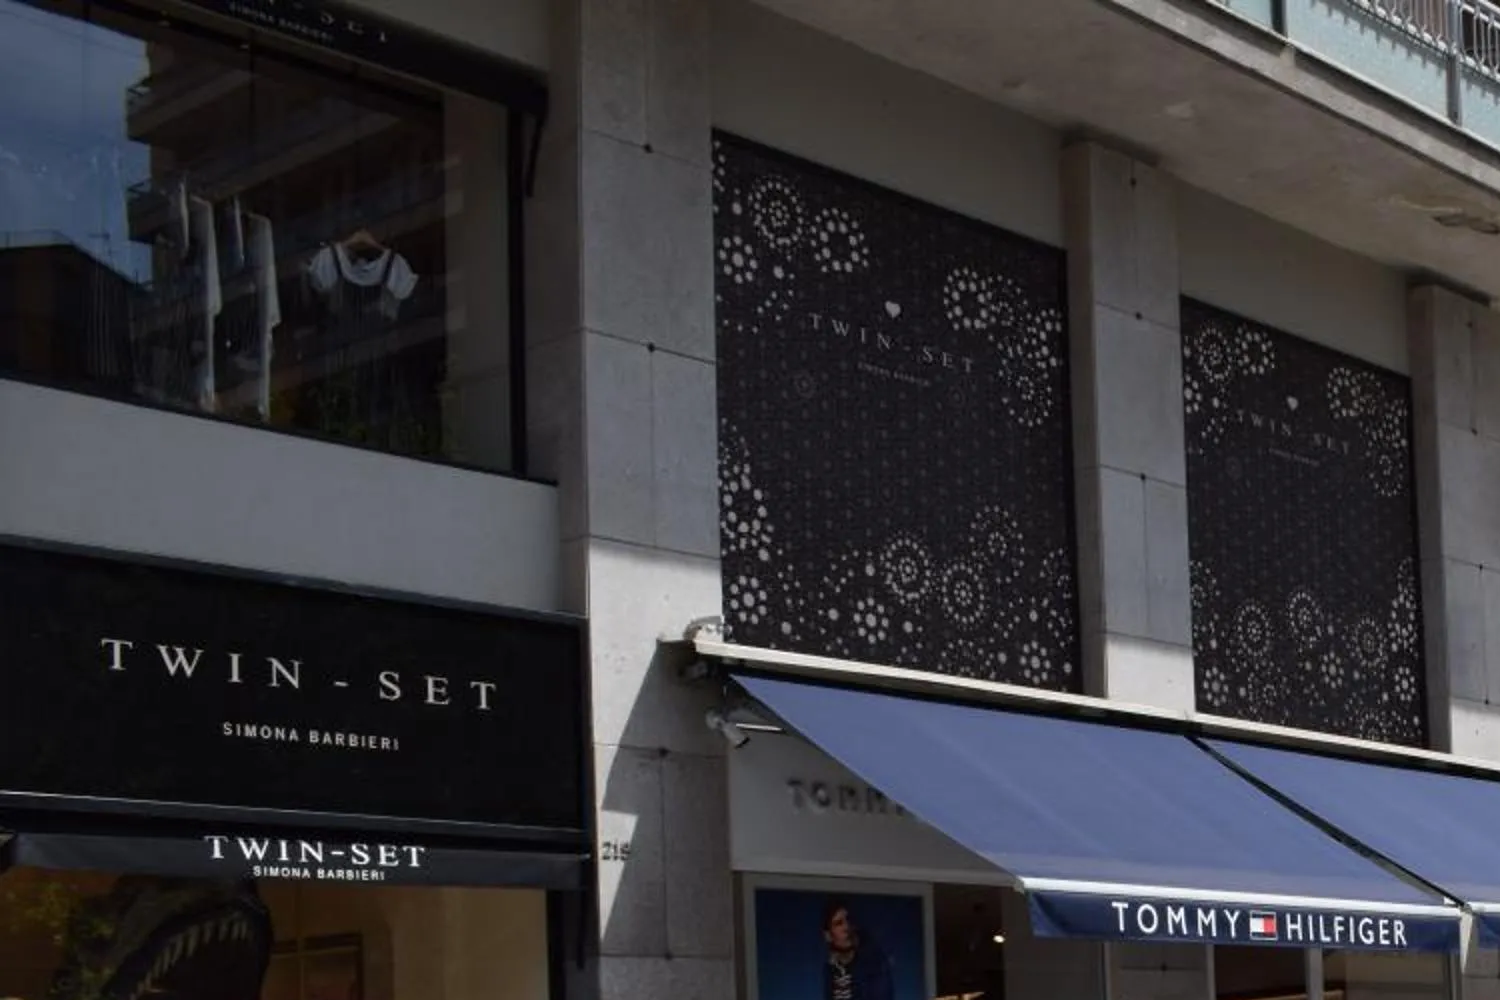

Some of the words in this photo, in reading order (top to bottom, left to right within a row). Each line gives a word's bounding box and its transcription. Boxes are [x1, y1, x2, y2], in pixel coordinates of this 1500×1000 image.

[223, 720, 299, 742] SIMONA
[309, 729, 400, 752] BARBIERI
[204, 834, 425, 867] TWIN-SET
[253, 865, 310, 879] SIMONA
[317, 868, 386, 882] BARBIERI
[1111, 901, 1240, 938] TOMMY
[1285, 912, 1408, 946] HILFIGER
